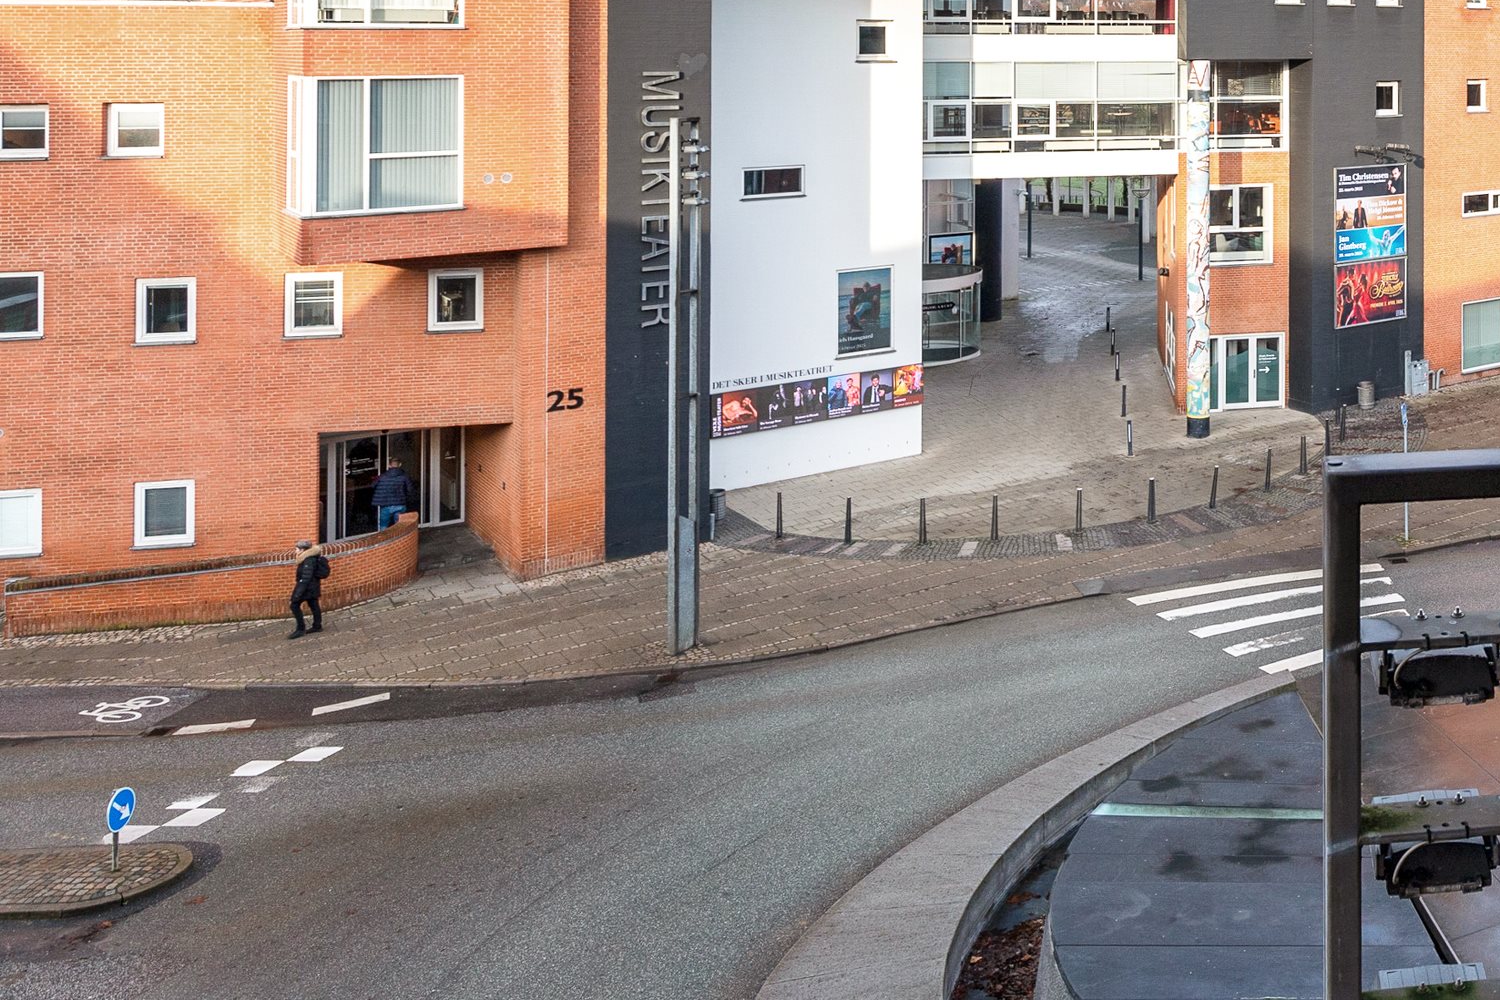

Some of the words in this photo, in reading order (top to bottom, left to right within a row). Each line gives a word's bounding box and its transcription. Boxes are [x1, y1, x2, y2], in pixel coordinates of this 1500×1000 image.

[712, 379, 733, 390] DET
[733, 376, 757, 387] SKER
[765, 364, 834, 382] MUSIKTEATRET
[546, 387, 584, 413] 25
